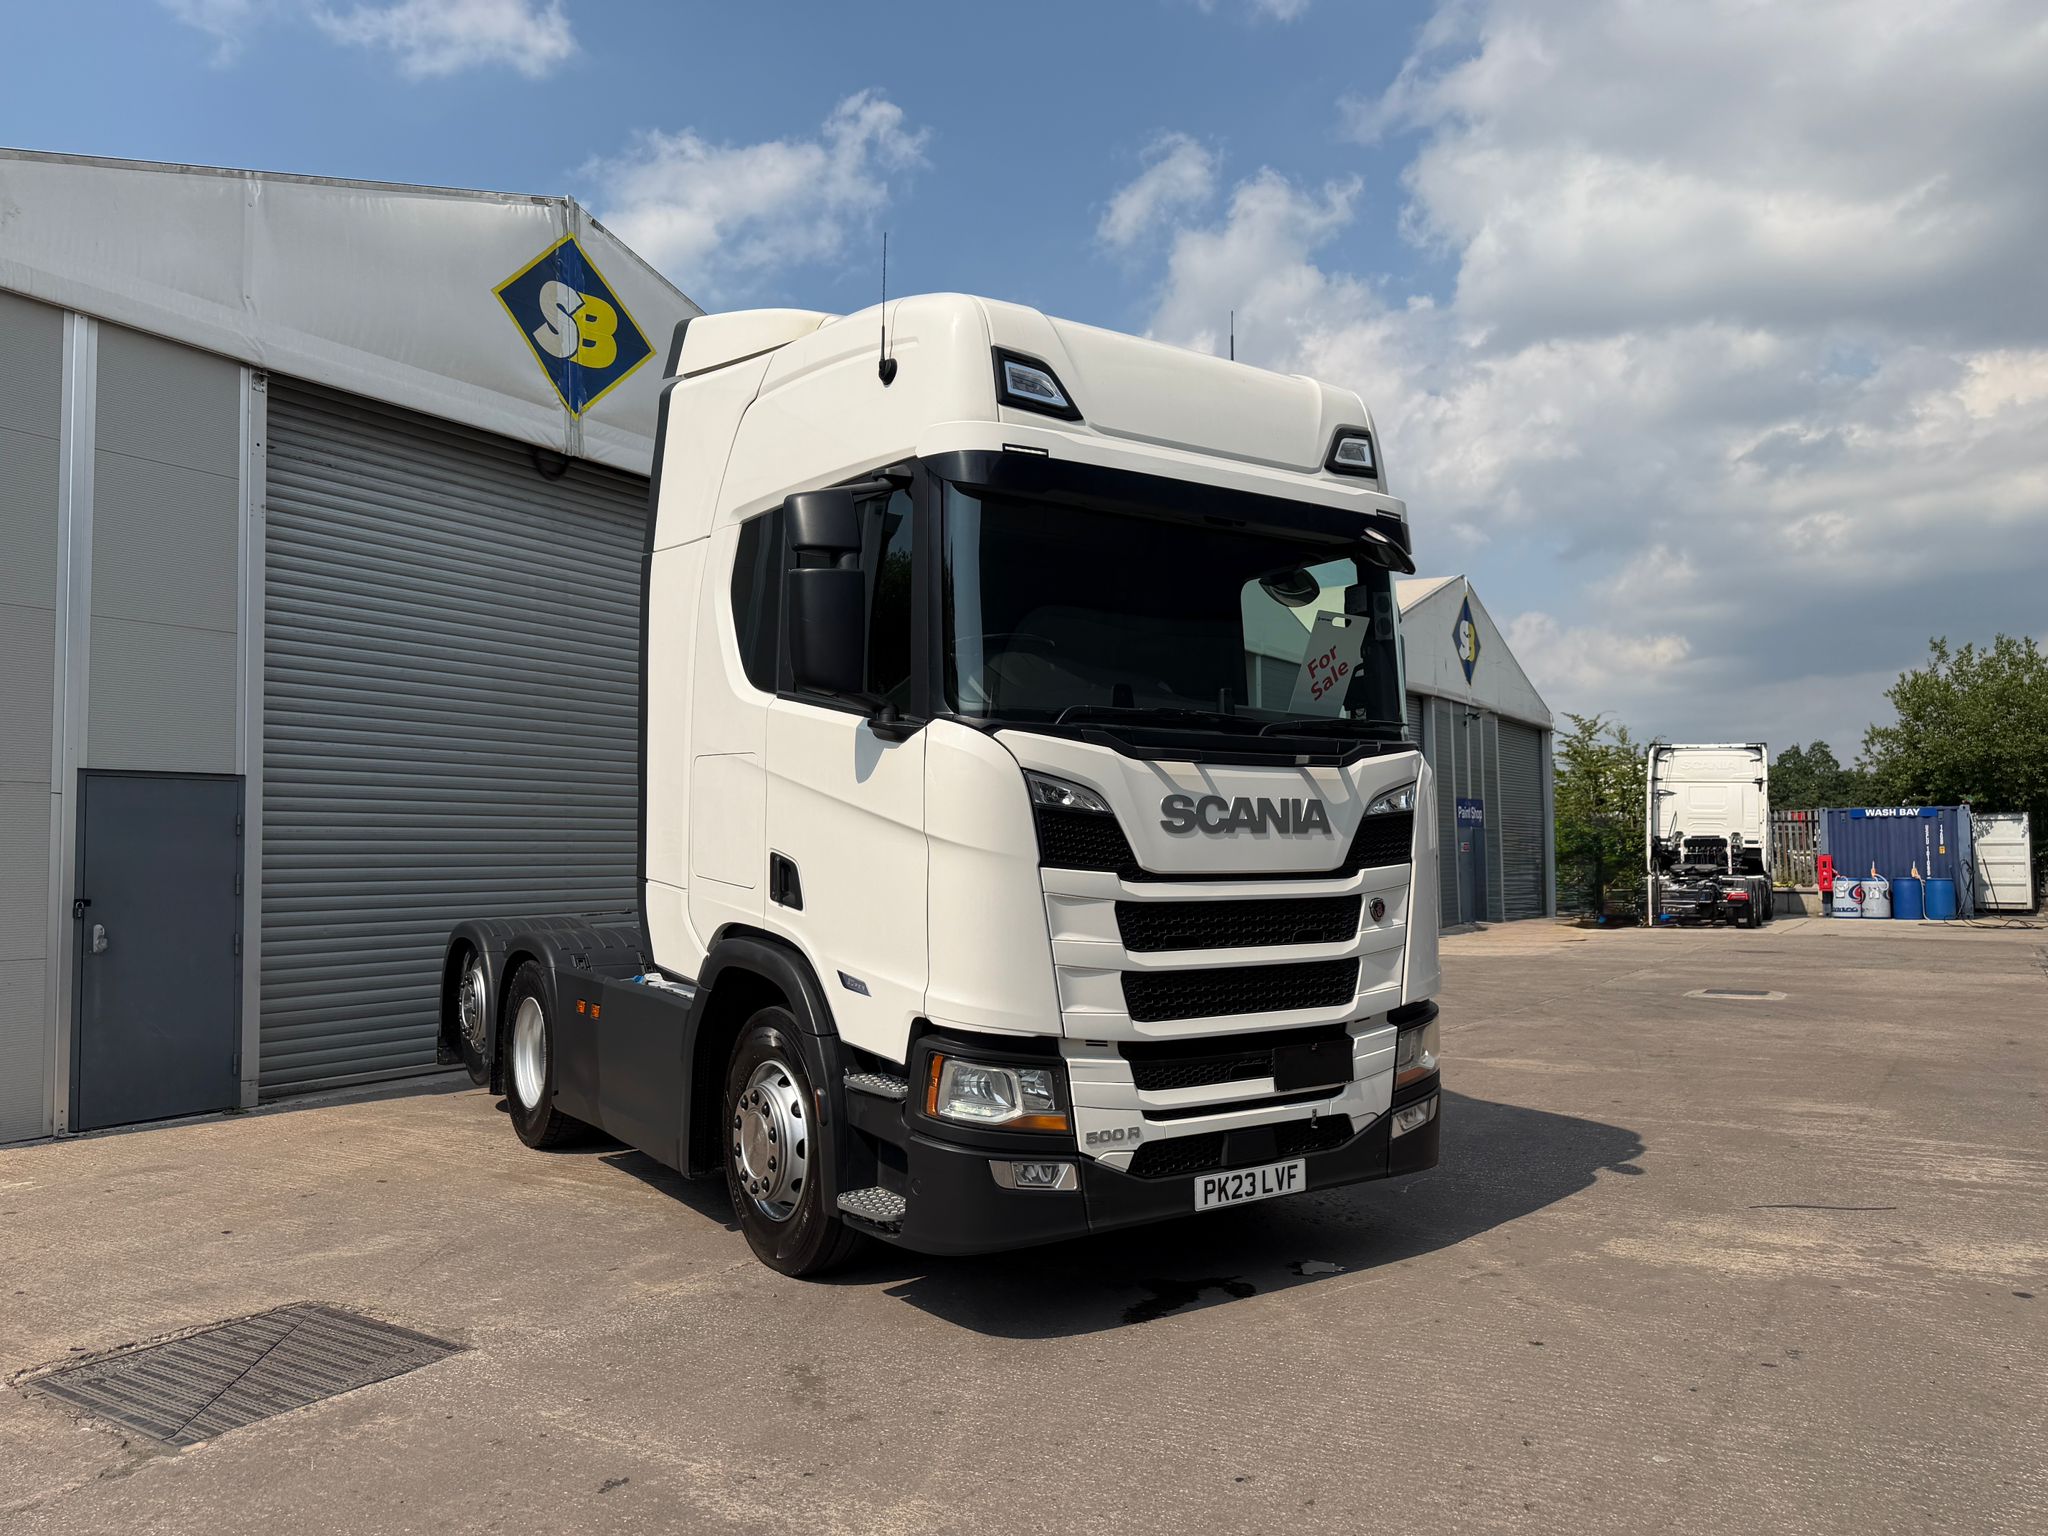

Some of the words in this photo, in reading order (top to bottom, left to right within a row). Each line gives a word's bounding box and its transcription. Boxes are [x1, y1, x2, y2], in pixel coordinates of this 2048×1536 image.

[532, 280, 619, 369] SB
[1459, 620, 1475, 662] SB
[1307, 645, 1337, 679] For
[1311, 661, 1349, 701] Sale
[1160, 794, 1332, 835] SCANIA
[1458, 805, 1471, 819] Paint
[1471, 806, 1482, 823] Shop
[1865, 808, 1897, 817] WASH
[1899, 808, 1920, 816] BAY
[1086, 1128, 1124, 1145] 500
[1127, 1126, 1140, 1140] R
[1204, 1172, 1256, 1206] PK23
[1262, 1164, 1298, 1194] LVF
